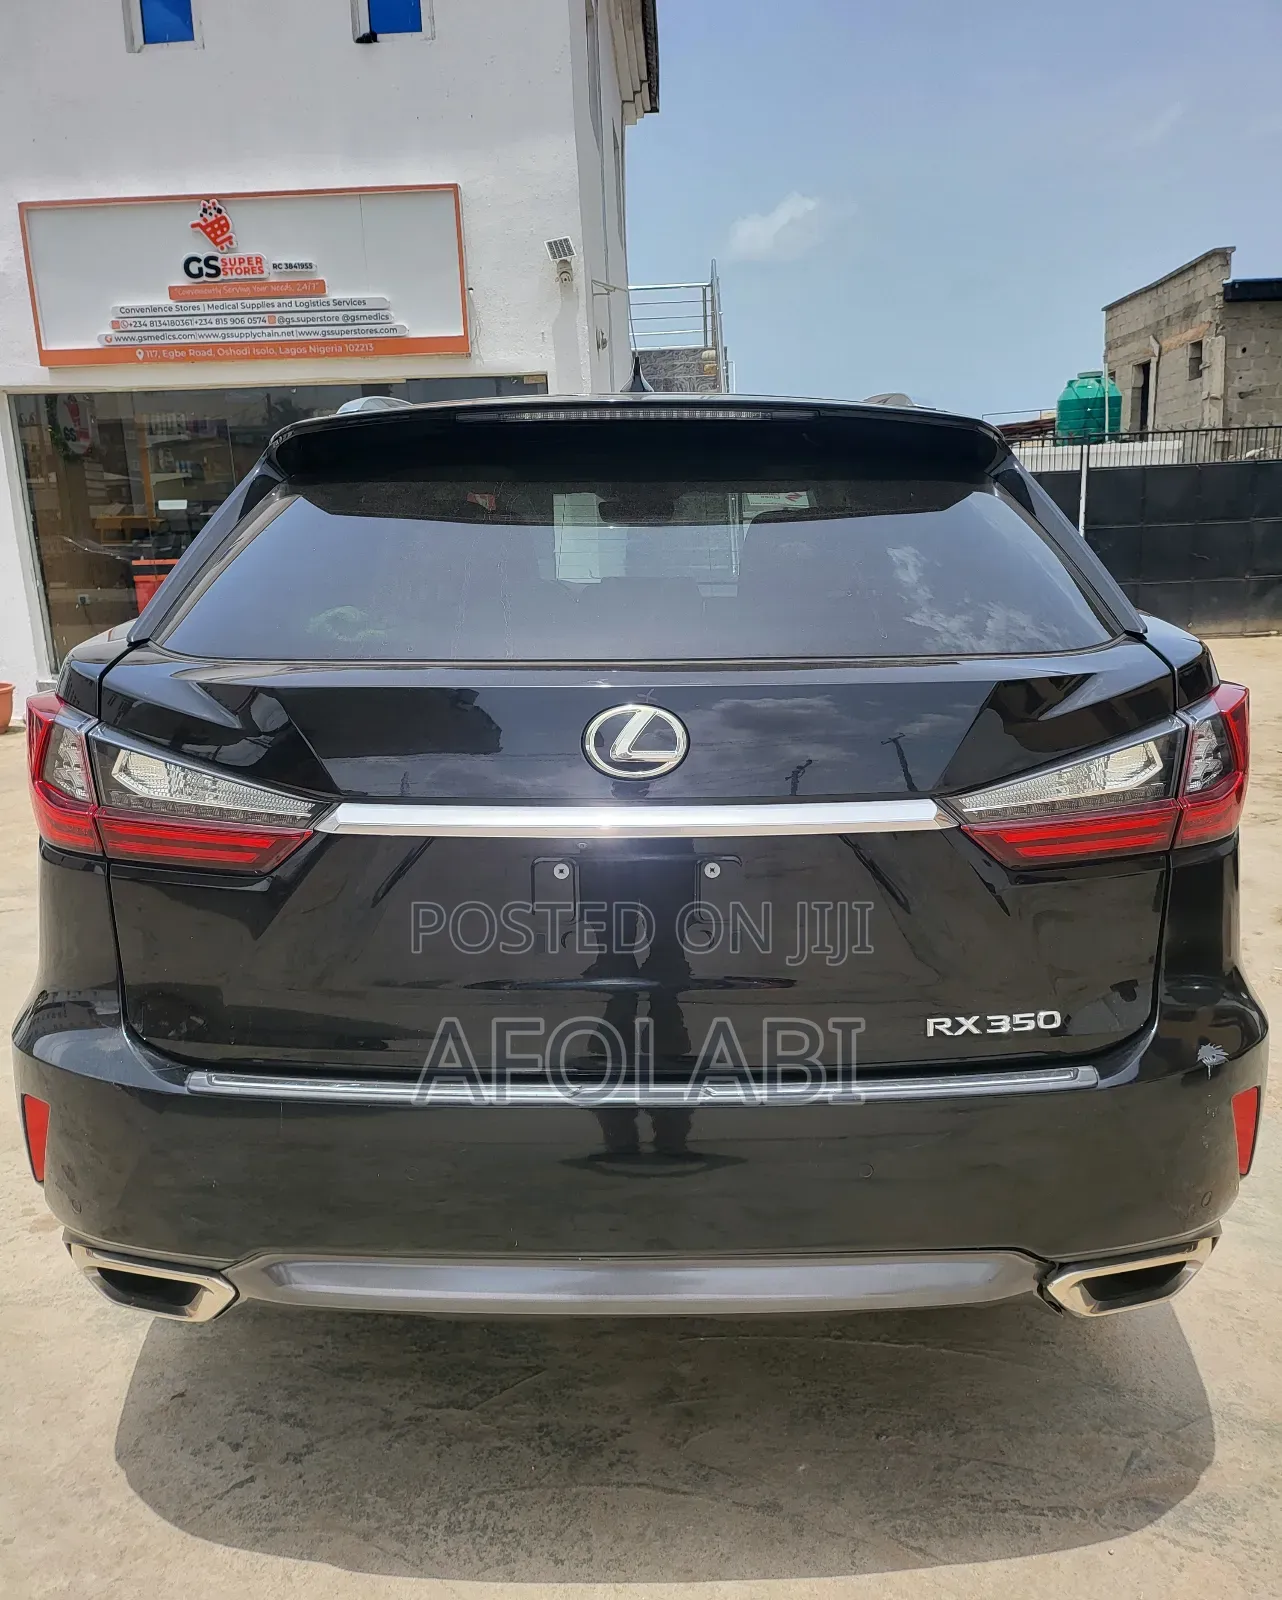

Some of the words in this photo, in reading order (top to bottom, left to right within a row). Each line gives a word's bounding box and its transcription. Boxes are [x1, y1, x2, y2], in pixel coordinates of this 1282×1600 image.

[184, 256, 221, 279] GS
[221, 257, 263, 266] SUPER
[222, 266, 265, 276] STORES
[223, 285, 250, 296] Serving
[252, 284, 268, 293] Your
[120, 304, 173, 314] Convenience
[175, 304, 200, 312] Stores
[207, 302, 239, 311] Medical
[241, 300, 275, 310] Supplies
[277, 300, 292, 308] and
[294, 300, 330, 310] Logistics
[332, 298, 366, 306] Services
[129, 320, 148, 328] +234
[248, 316, 266, 324] 0574
[342, 312, 390, 322] @gsmedics
[162, 350, 186, 359] Egbe
[188, 348, 216, 358] Road,
[217, 346, 250, 356] Oshodi
[279, 345, 307, 356] Lagos
[308, 344, 342, 354] Nigeria
[345, 344, 374, 352] 102213
